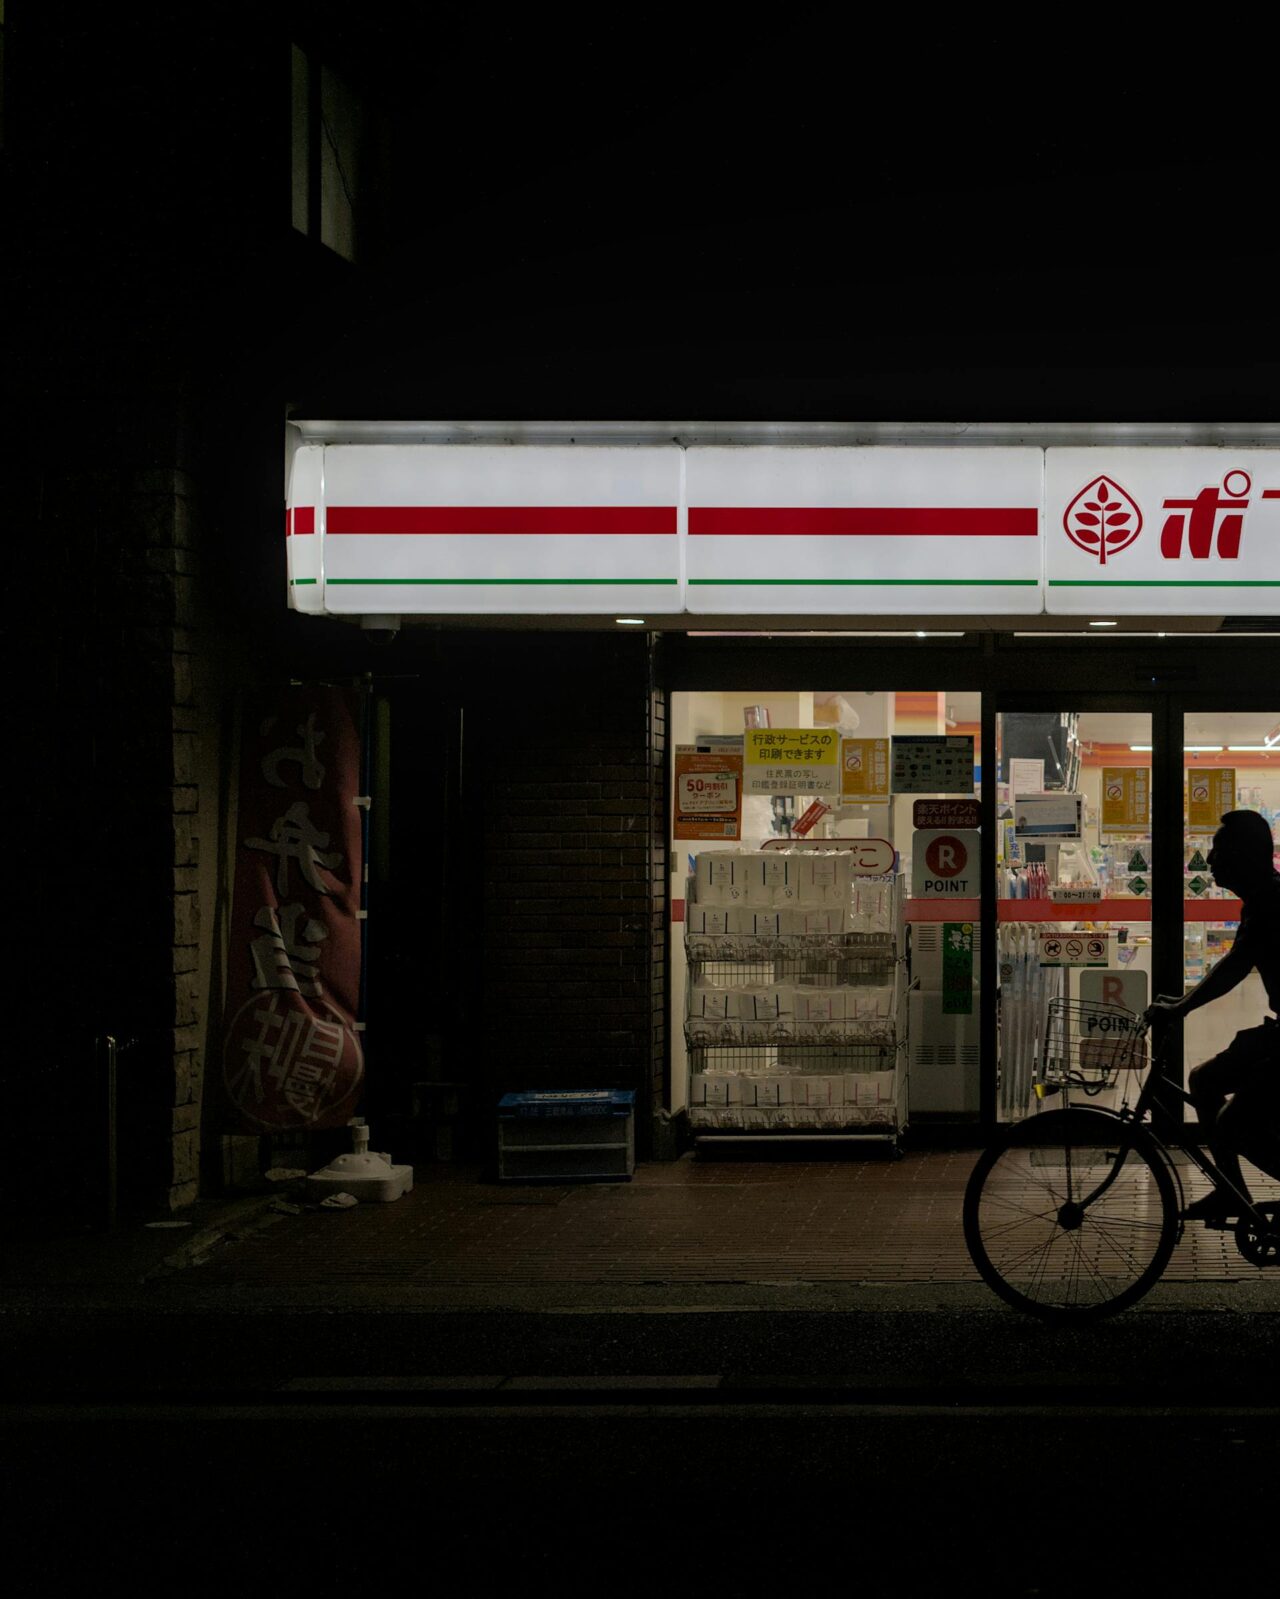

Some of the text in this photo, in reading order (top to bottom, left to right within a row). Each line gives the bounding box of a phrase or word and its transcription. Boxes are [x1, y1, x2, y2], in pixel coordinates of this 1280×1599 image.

[752, 734, 832, 746] 行政サービスの
[759, 748, 825, 760] 印刷できます
[687, 779, 728, 792] 50円割引
[692, 792, 721, 800] クーポン
[925, 880, 968, 892] POINT
